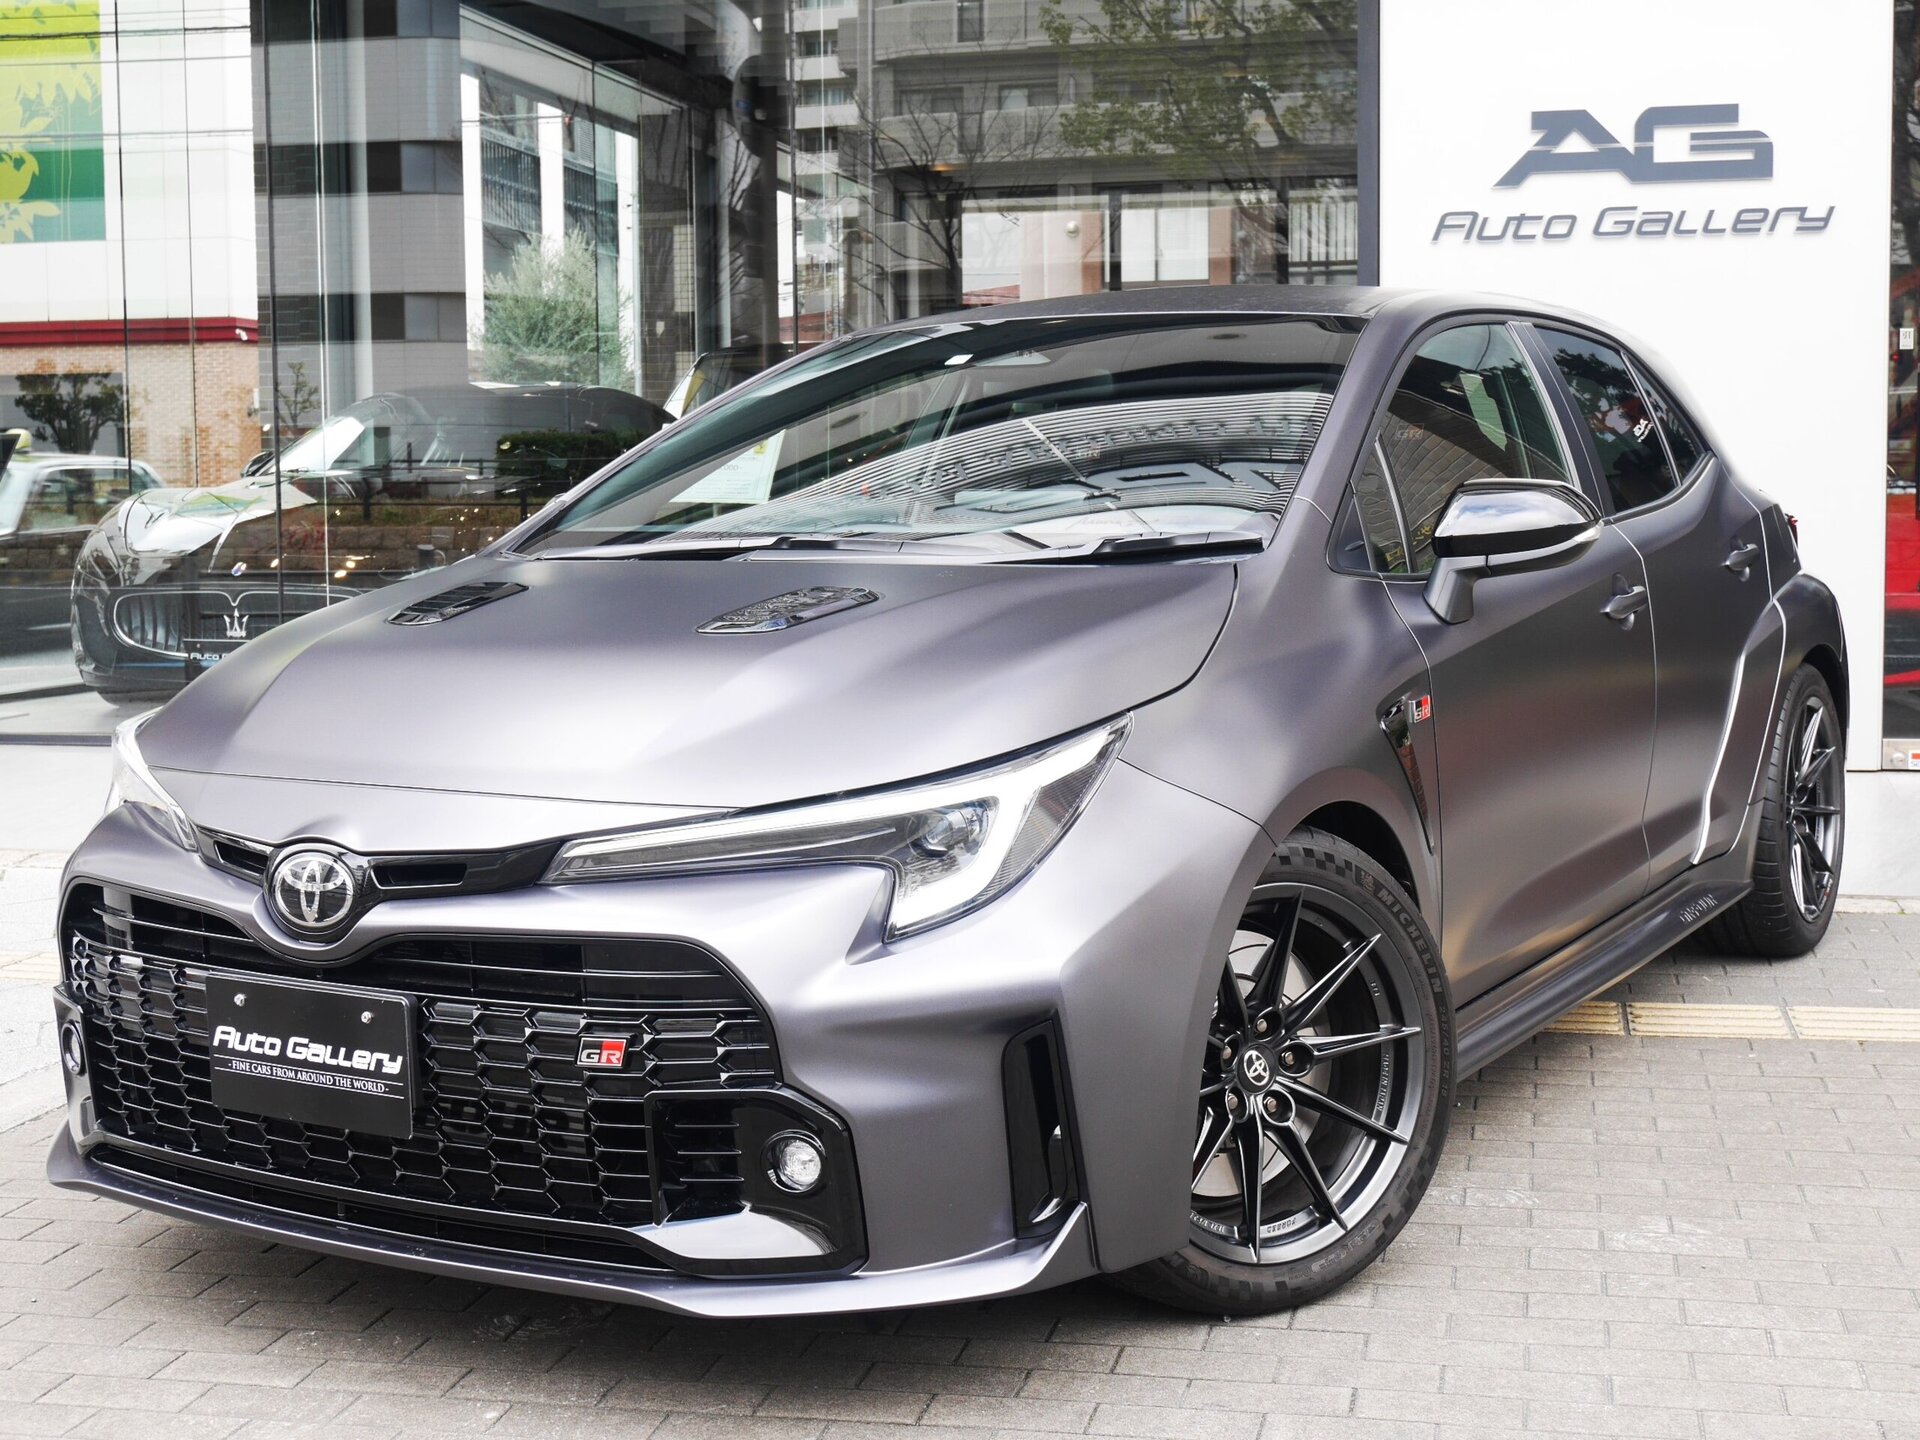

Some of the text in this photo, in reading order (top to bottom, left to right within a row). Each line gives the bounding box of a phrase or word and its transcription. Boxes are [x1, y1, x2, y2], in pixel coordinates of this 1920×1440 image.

[1491, 103, 1774, 190] AG
[1430, 205, 1836, 243] Auto Gallery
[190, 652, 220, 661] Auto
[1377, 888, 1443, 993] MICHELIN
[212, 1025, 404, 1075] Auto Gallery
[581, 1049, 621, 1064] GR
[251, 1063, 272, 1075] CARS
[272, 1066, 296, 1079] FROM
[296, 1070, 334, 1085] AROUND
[334, 1076, 352, 1088] THE
